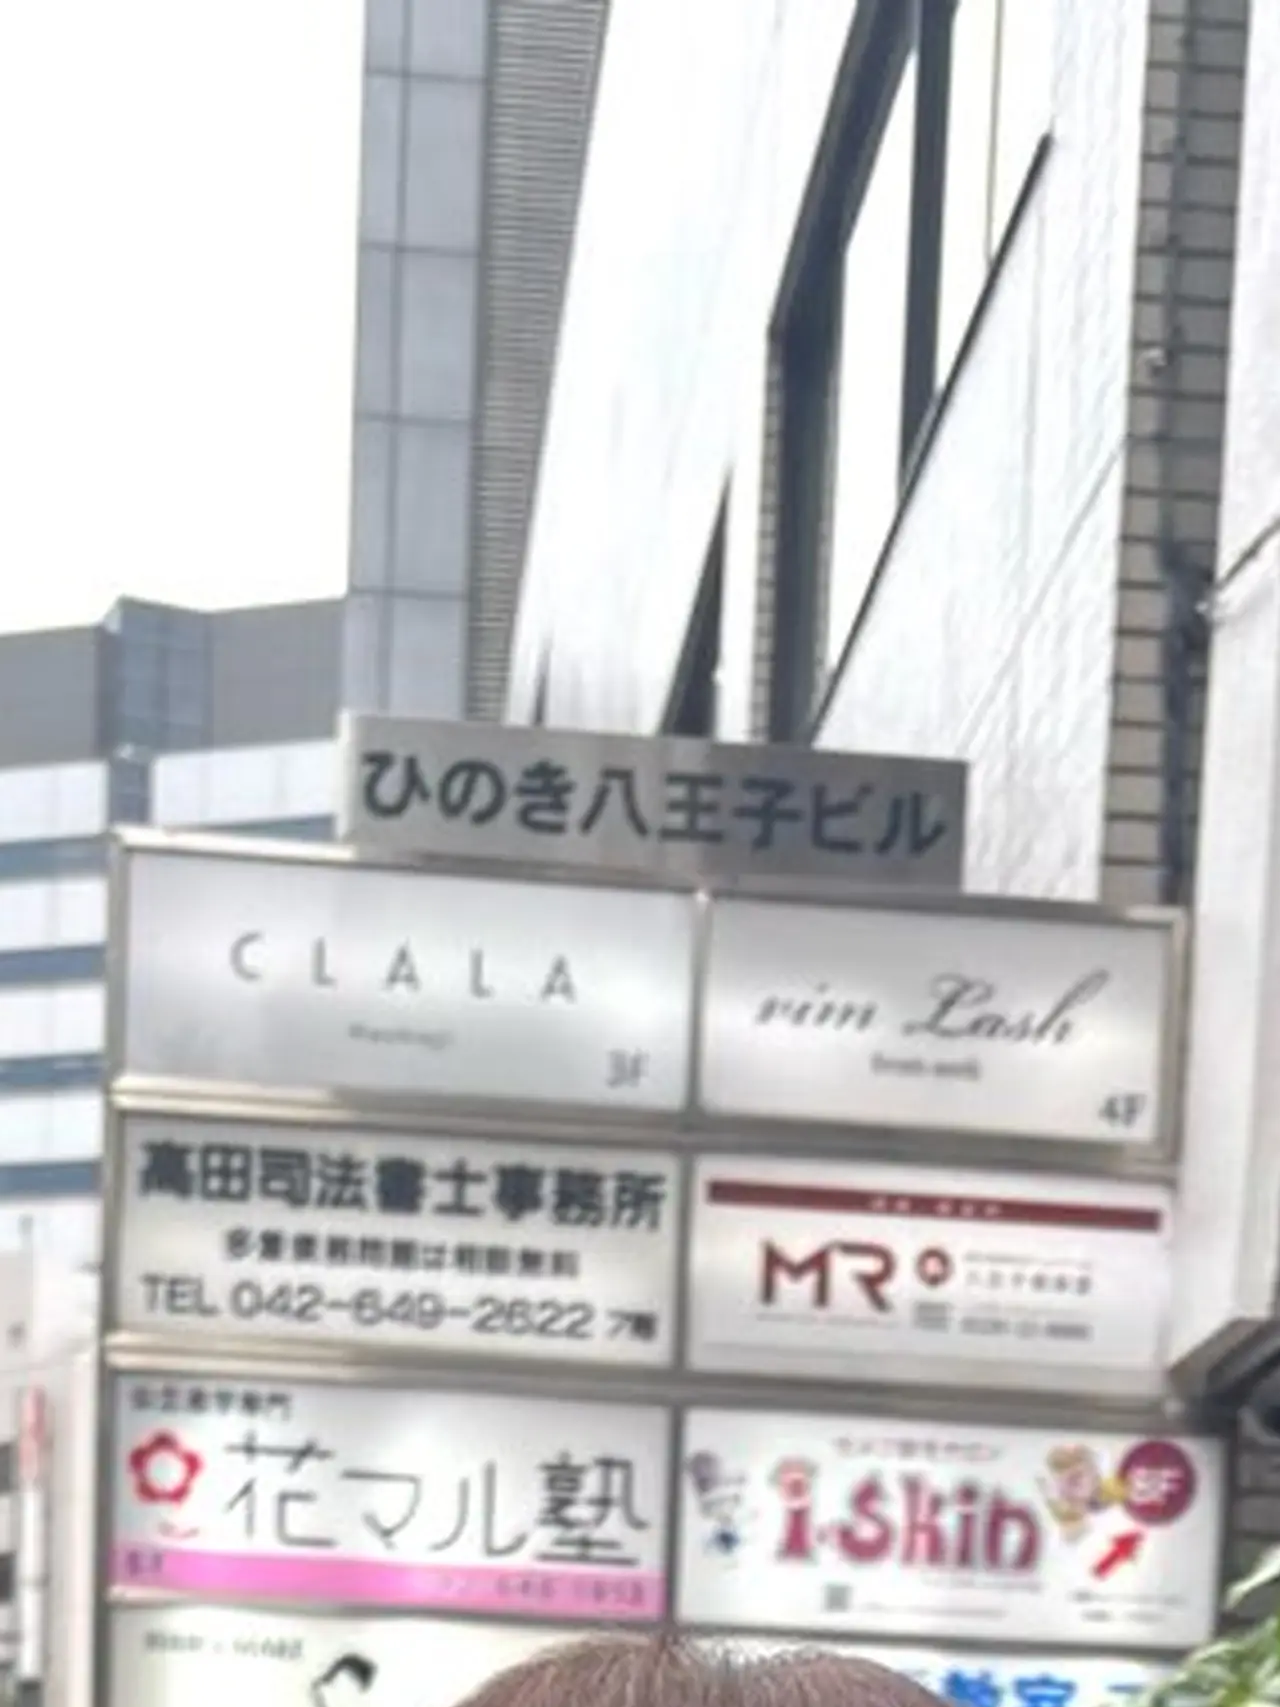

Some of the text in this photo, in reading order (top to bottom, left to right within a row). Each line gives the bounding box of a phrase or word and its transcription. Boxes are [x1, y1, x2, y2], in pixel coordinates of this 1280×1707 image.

[361, 751, 947, 856] ひのき八王子ビル
[901, 968, 1111, 1046] Lash
[138, 1137, 668, 1233] 高田司法書士事務所
[140, 1273, 222, 1317] TEL
[230, 1280, 596, 1342] 042-649-2622
[222, 1428, 650, 1568] 花マル塾
